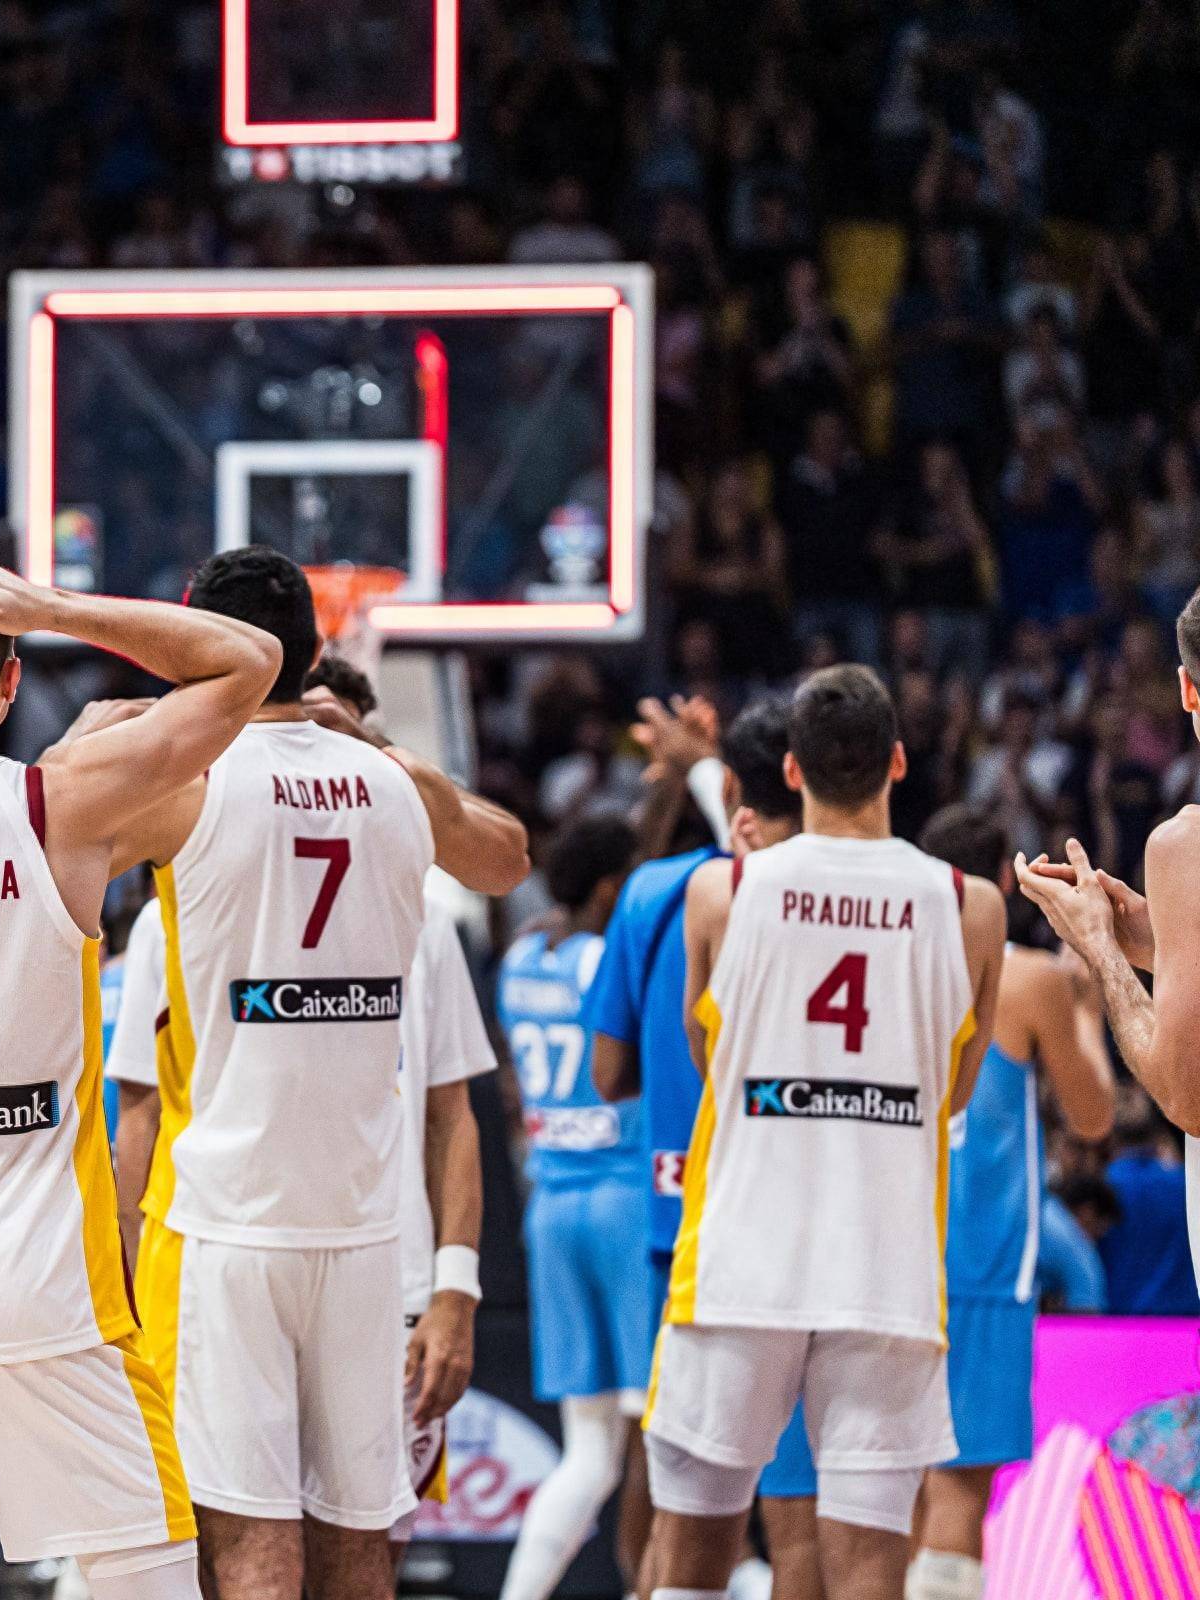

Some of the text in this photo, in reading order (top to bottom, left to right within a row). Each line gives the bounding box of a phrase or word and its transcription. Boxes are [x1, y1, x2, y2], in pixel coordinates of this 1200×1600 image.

[272, 774, 372, 811] ALDAMA
[294, 836, 351, 949] 7
[782, 889, 914, 930] PRADILLA
[272, 983, 400, 1018] CaixaBank
[806, 951, 869, 1053] 4
